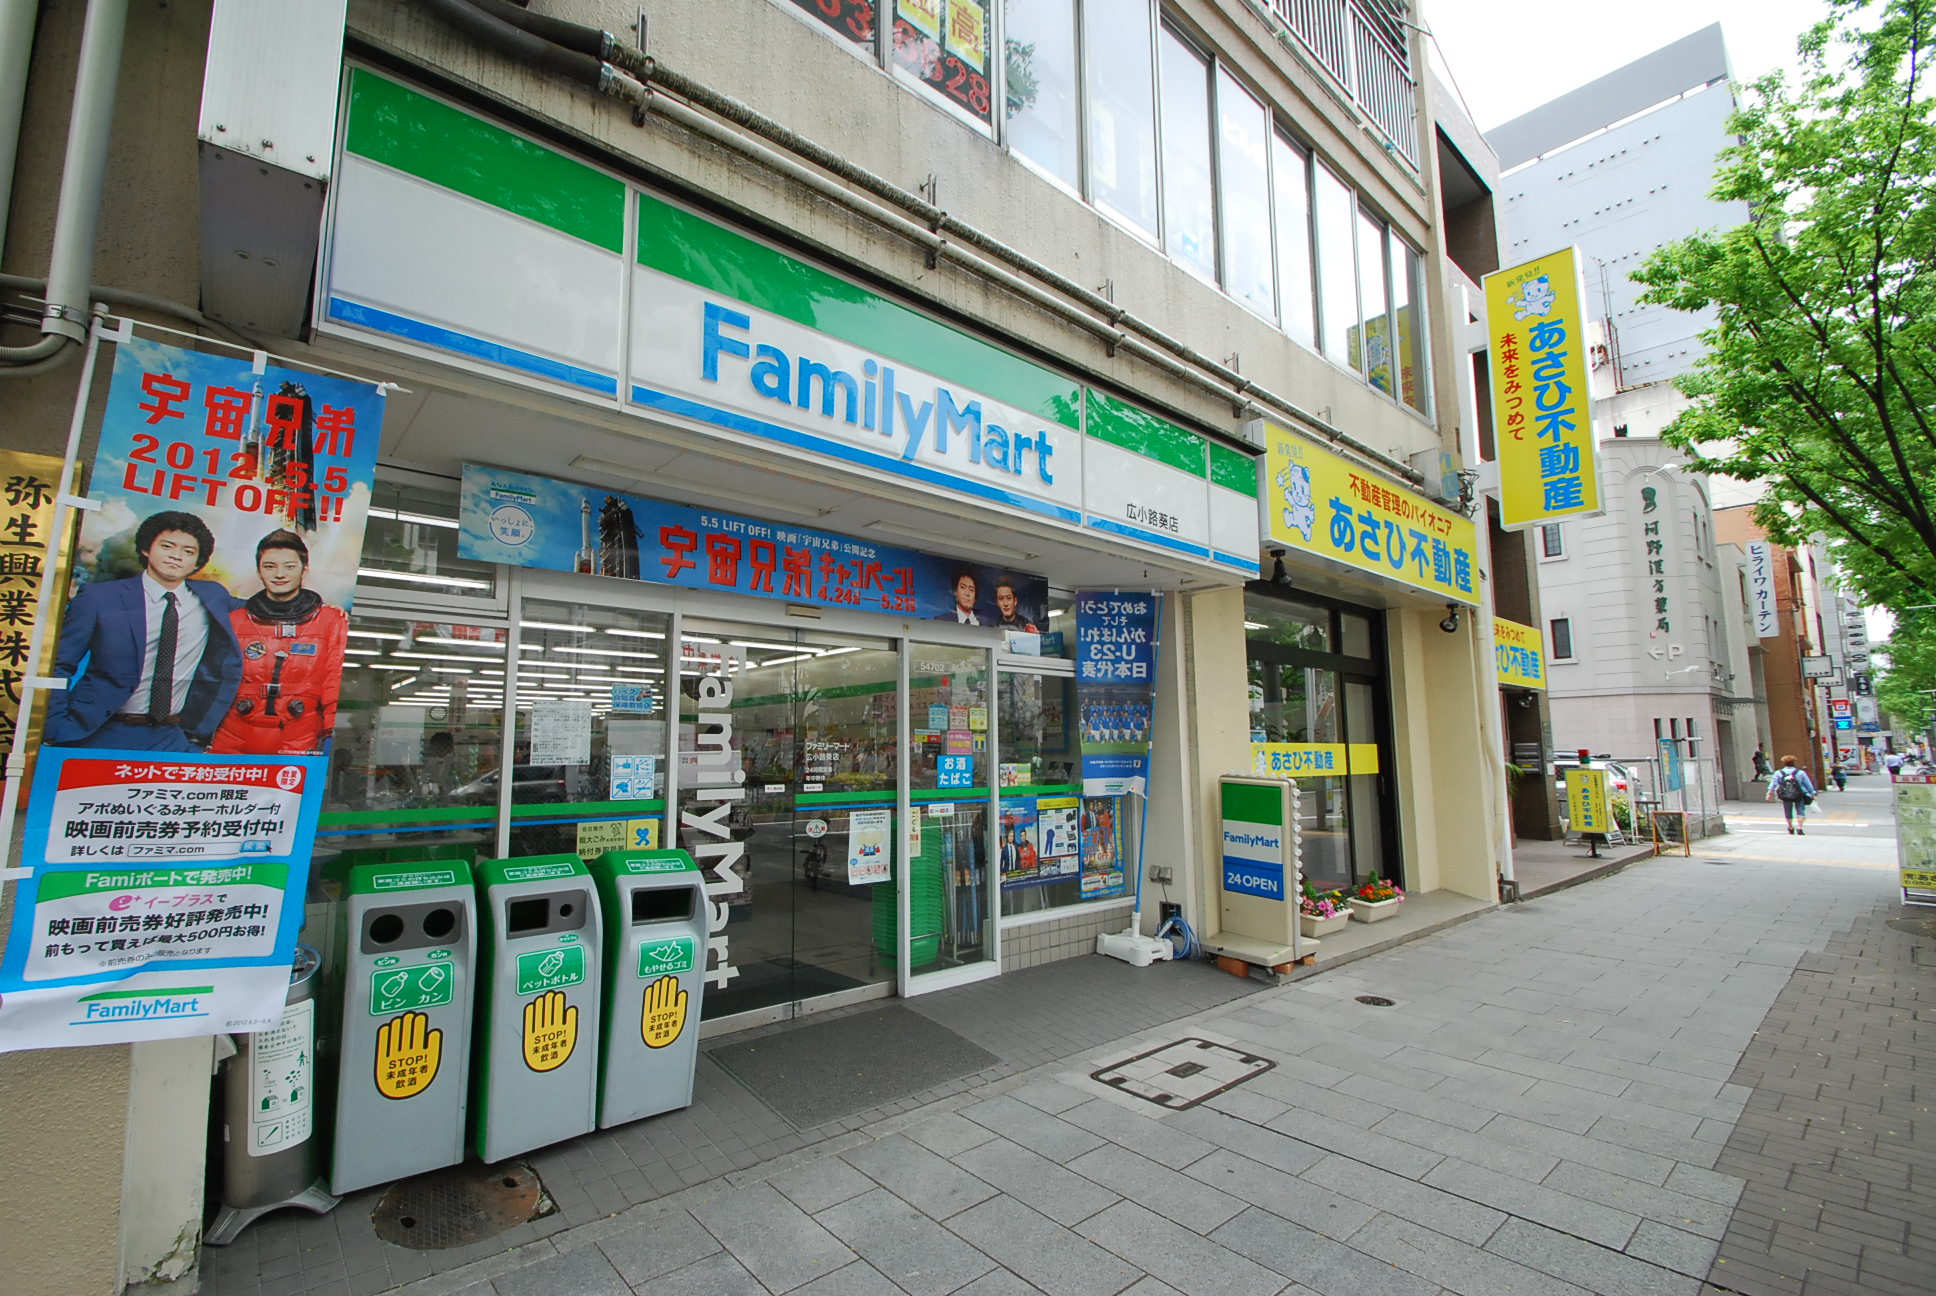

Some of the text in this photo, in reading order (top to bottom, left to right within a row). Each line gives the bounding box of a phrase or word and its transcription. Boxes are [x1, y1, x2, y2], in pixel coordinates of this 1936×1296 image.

[700, 300, 1053, 486] FamilyMart
[1500, 332, 1525, 441] 未来をみつめて
[139, 372, 356, 458] 宇宙兄弟
[1528, 318, 1585, 512] あさひ不動産
[128, 433, 348, 493] 2012.5.5
[123, 463, 227, 507] LIFT
[1349, 472, 1452, 537] 不動産管理のパイオニア
[701, 516, 771, 539] 5.5 LIFT OFF!
[1329, 496, 1472, 594] あさひ不動産
[659, 524, 812, 598] 宇宙兄弟
[1750, 545, 1772, 633] ヒライワカーテン
[920, 662, 945, 672] 54702
[806, 742, 850, 752] ファミリーマート
[944, 757, 967, 770] お酒
[1271, 750, 1334, 771] あさひ不動産
[114, 765, 267, 782] ネットで予約受付中!
[939, 773, 971, 785] たばこ
[77, 802, 281, 816] アポぬいぐるみキーホルダー付
[64, 819, 284, 839] 映画前売券予約受付中!
[1223, 831, 1279, 849] FamilyMart
[70, 845, 125, 857] 詳しくは
[134, 845, 205, 855] ファミマ.com
[85, 866, 252, 888] Famiポートで発売中!
[1243, 874, 1278, 892] OPEN
[48, 904, 269, 937] 映画前売券好評発売中!
[44, 925, 266, 958] 前もって買えば最大500円お得!
[644, 961, 688, 974] もやせるゴミ
[523, 971, 579, 989] ペットボトル
[87, 998, 199, 1020] FamilyMart
[381, 993, 443, 1010] ビン カン
[648, 1019, 678, 1033] 未成年者
[650, 1011, 677, 1024] STOP!
[534, 1029, 567, 1045] STOP!
[654, 1029, 670, 1040] 飲酒
[532, 1039, 568, 1054] 未成年者
[388, 1053, 428, 1070] STOP!
[540, 1051, 559, 1063] 飲酒
[386, 1065, 428, 1080] 未成年者
[395, 1077, 417, 1089] 飲酒
